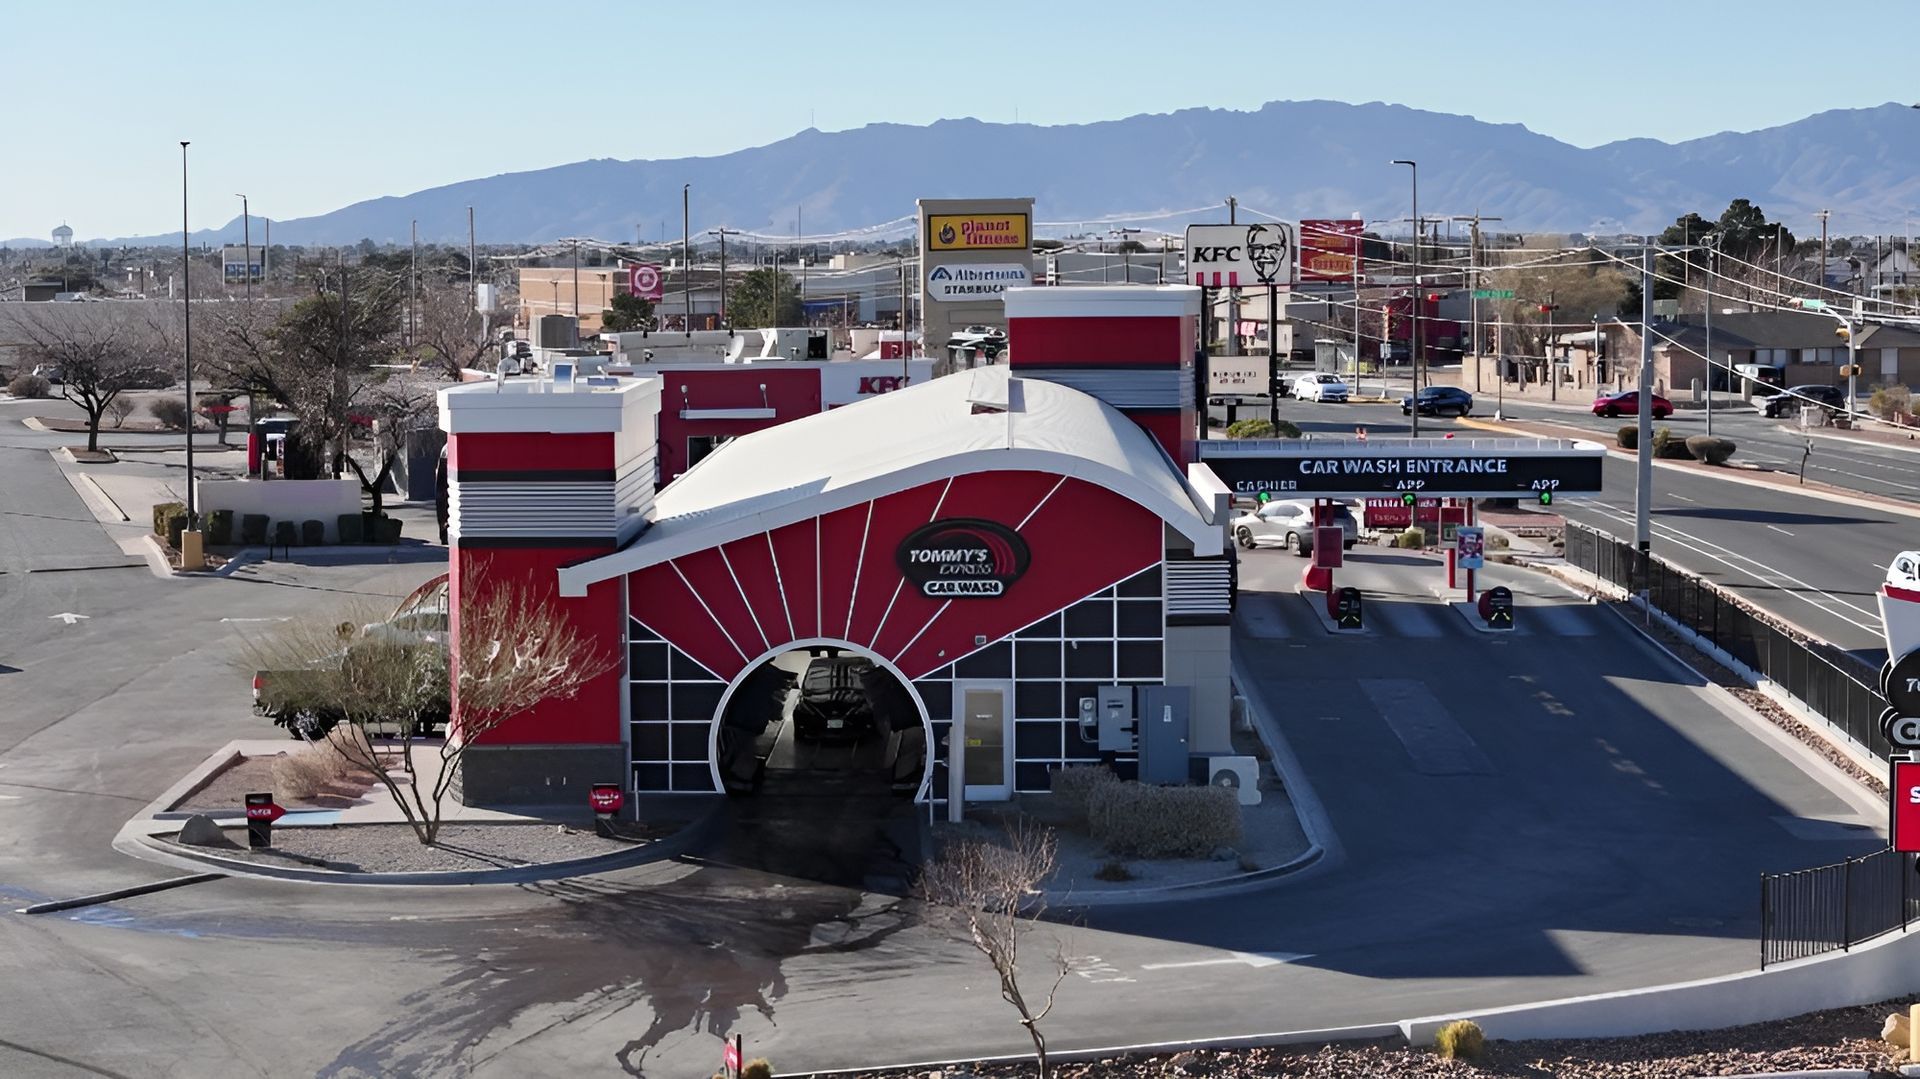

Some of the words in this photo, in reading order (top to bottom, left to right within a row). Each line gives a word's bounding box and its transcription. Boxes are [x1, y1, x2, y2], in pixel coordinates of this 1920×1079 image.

[1192, 246, 1241, 263] KFC
[1300, 460, 1339, 474] CAR
[1342, 459, 1400, 474] WASH
[1406, 459, 1508, 473] ENTRANCE
[1236, 480, 1297, 491] CASHIER
[1396, 479, 1425, 490] APP
[1531, 479, 1560, 490] APP
[910, 549, 988, 563] TOMMY'S
[927, 581, 955, 594] CAR
[957, 581, 1000, 594] WASH
